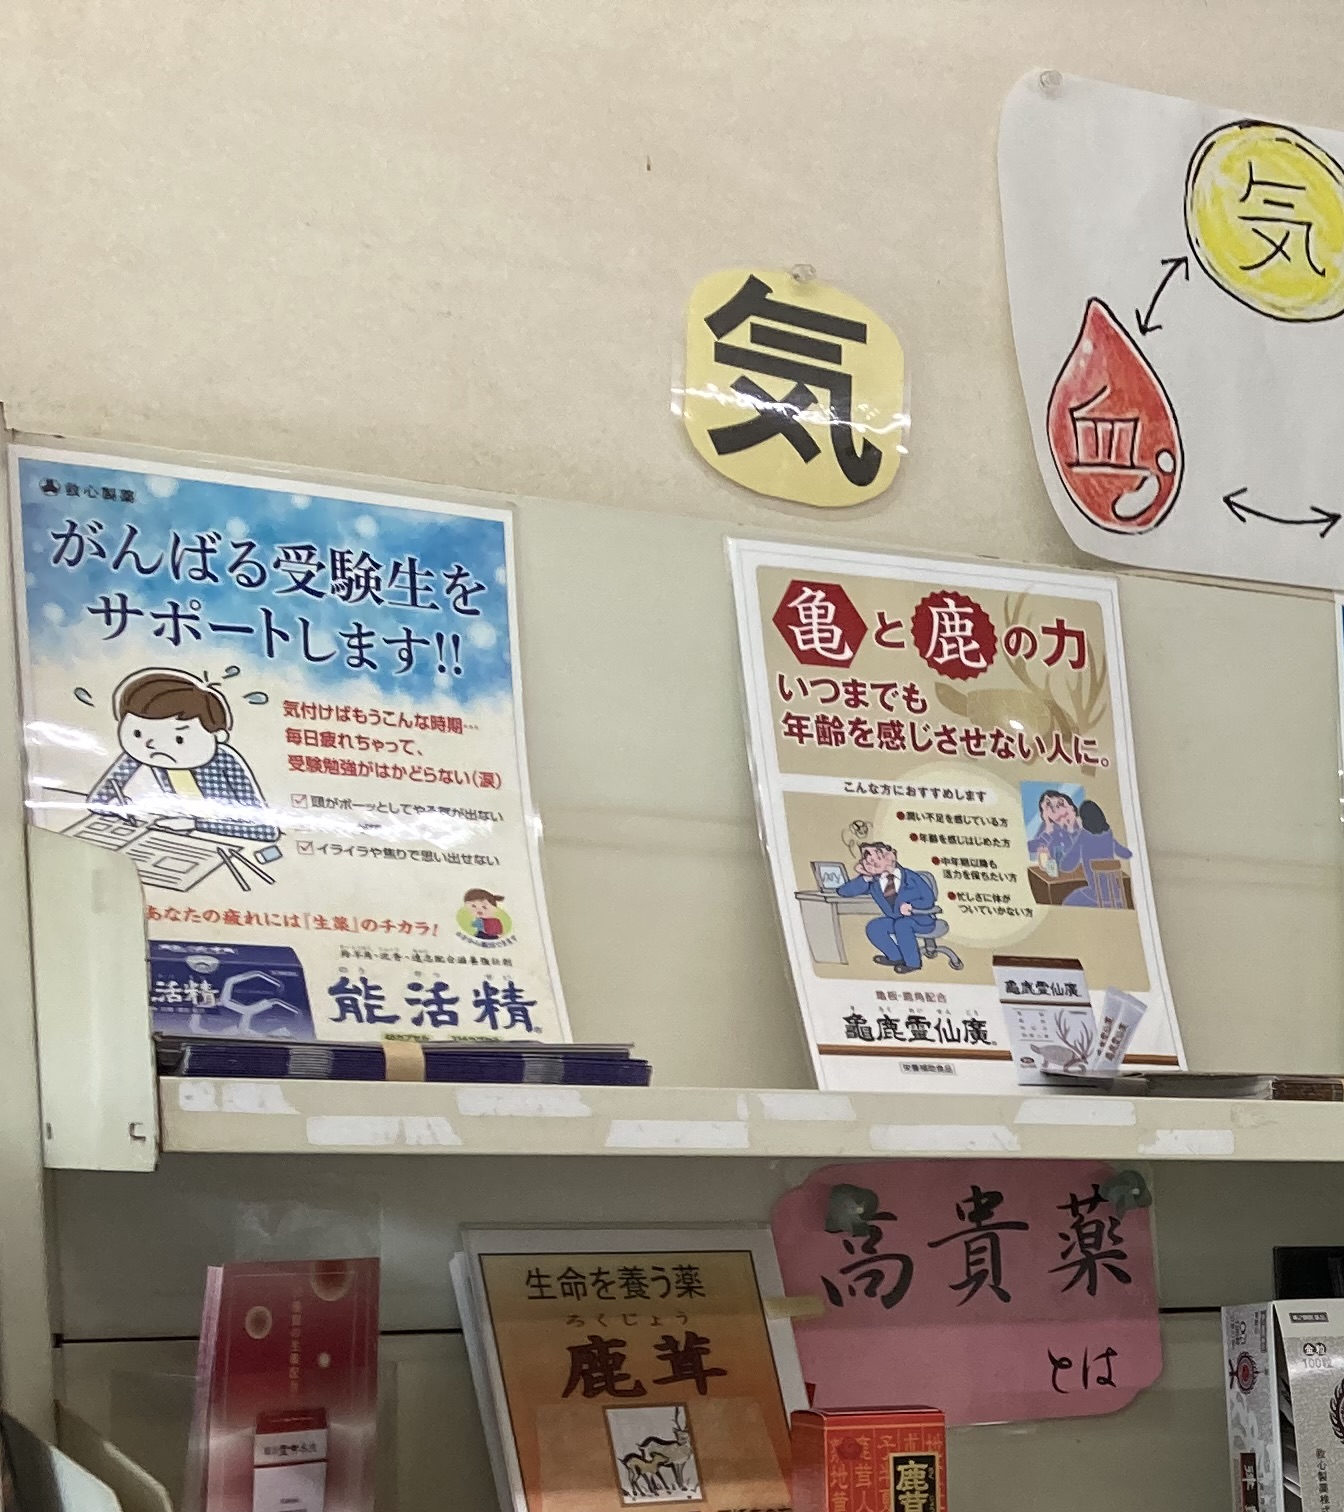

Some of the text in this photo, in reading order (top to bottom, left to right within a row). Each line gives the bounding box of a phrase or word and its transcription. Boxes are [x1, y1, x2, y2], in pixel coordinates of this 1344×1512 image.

[1239, 162, 1325, 277] 気
[704, 275, 882, 485] 気
[1070, 386, 1151, 476] 血
[49, 518, 487, 618] がんばる受験生を
[87, 598, 464, 678] サポートします!!
[786, 585, 1086, 672] 亀と鹿の力
[778, 674, 928, 714] いつまでも
[285, 727, 424, 756] 毎日疲れちゃって、
[782, 715, 1110, 768] 年齢を感じさせない人に。
[288, 754, 502, 789] 受験勉強がはかどらない(涙)
[844, 781, 986, 802] こんな方におすすめします
[328, 977, 539, 1034] 能活精
[821, 1183, 1133, 1311] 高貴薬
[525, 1267, 706, 1302] 生命を養う薬
[564, 1311, 691, 1328] ろくじょう
[560, 1336, 728, 1398] 鹿茸
[1046, 1347, 1117, 1391] とは
